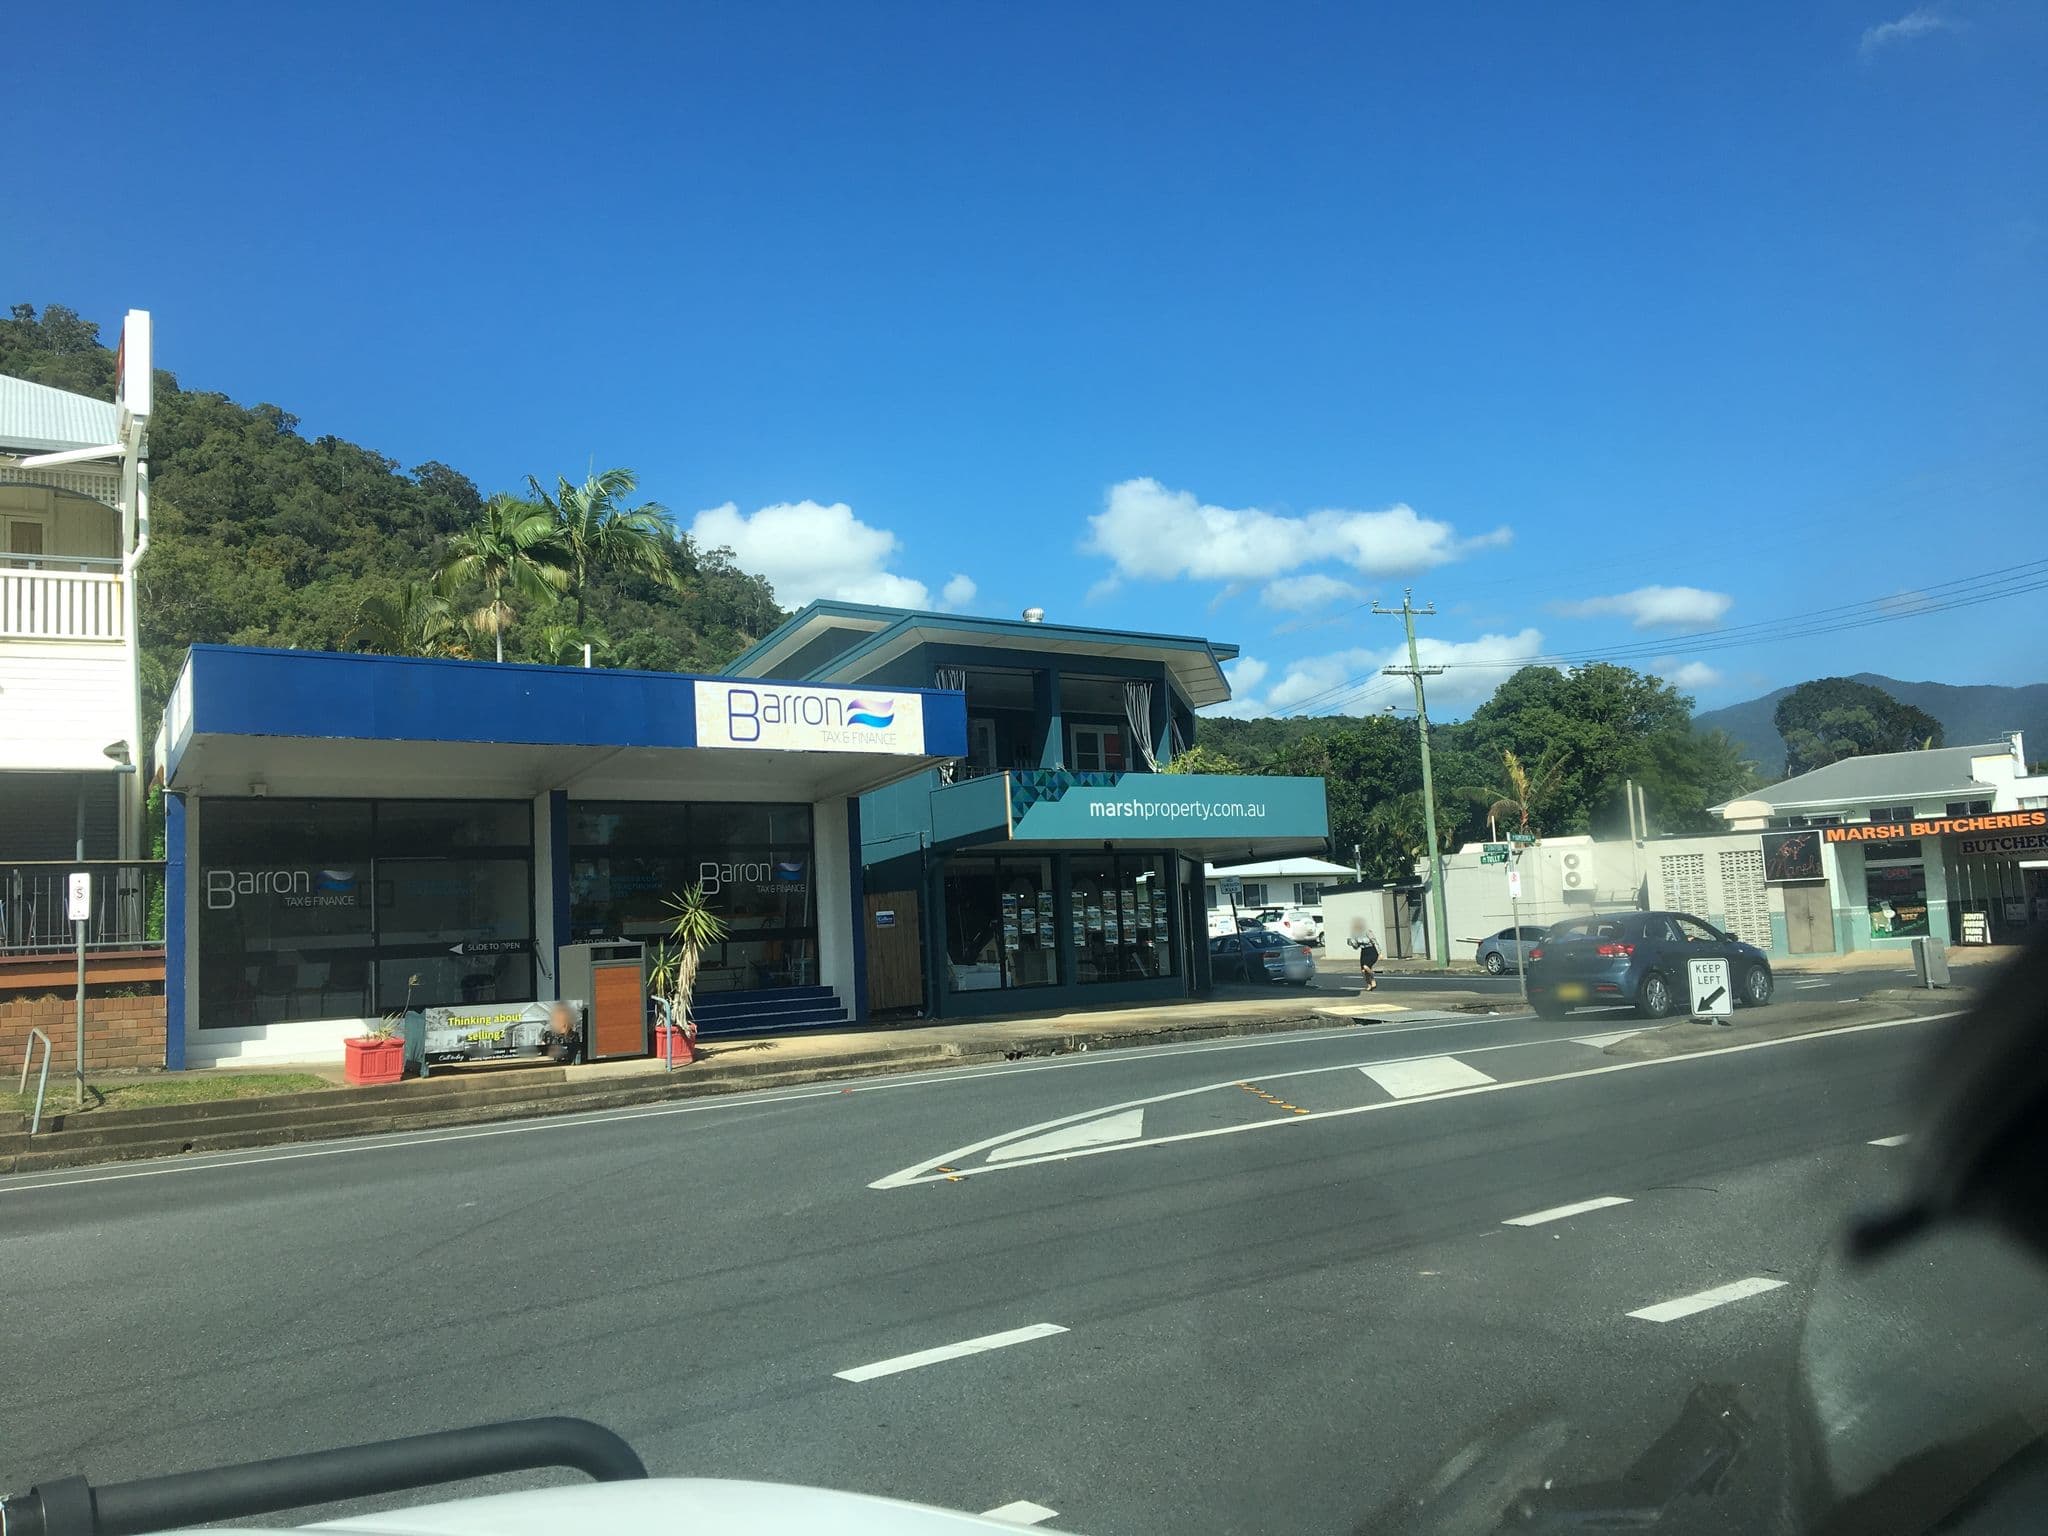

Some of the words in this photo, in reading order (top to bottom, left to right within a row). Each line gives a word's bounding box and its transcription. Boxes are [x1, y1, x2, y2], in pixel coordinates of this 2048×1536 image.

[728, 689, 843, 742] Barron
[821, 730, 841, 744] TAX
[842, 731, 850, 744] &
[852, 731, 897, 746] FINANCE
[1090, 799, 1265, 820] marshproperty.com.au
[1826, 825, 1905, 842] MARSH
[1910, 812, 2047, 836] BUTCHERIES
[700, 862, 772, 895] Barron
[207, 870, 310, 910] Barron
[756, 884, 770, 893] TAX
[776, 883, 806, 893] FINANCE
[285, 897, 305, 907] TAX
[313, 895, 355, 906] FINANCE
[1695, 964, 1721, 973] KEEP
[1697, 975, 1721, 985] LEFT
[448, 1015, 491, 1026] Thinking
[494, 1013, 522, 1023] about
[467, 1029, 505, 1041] selling?
